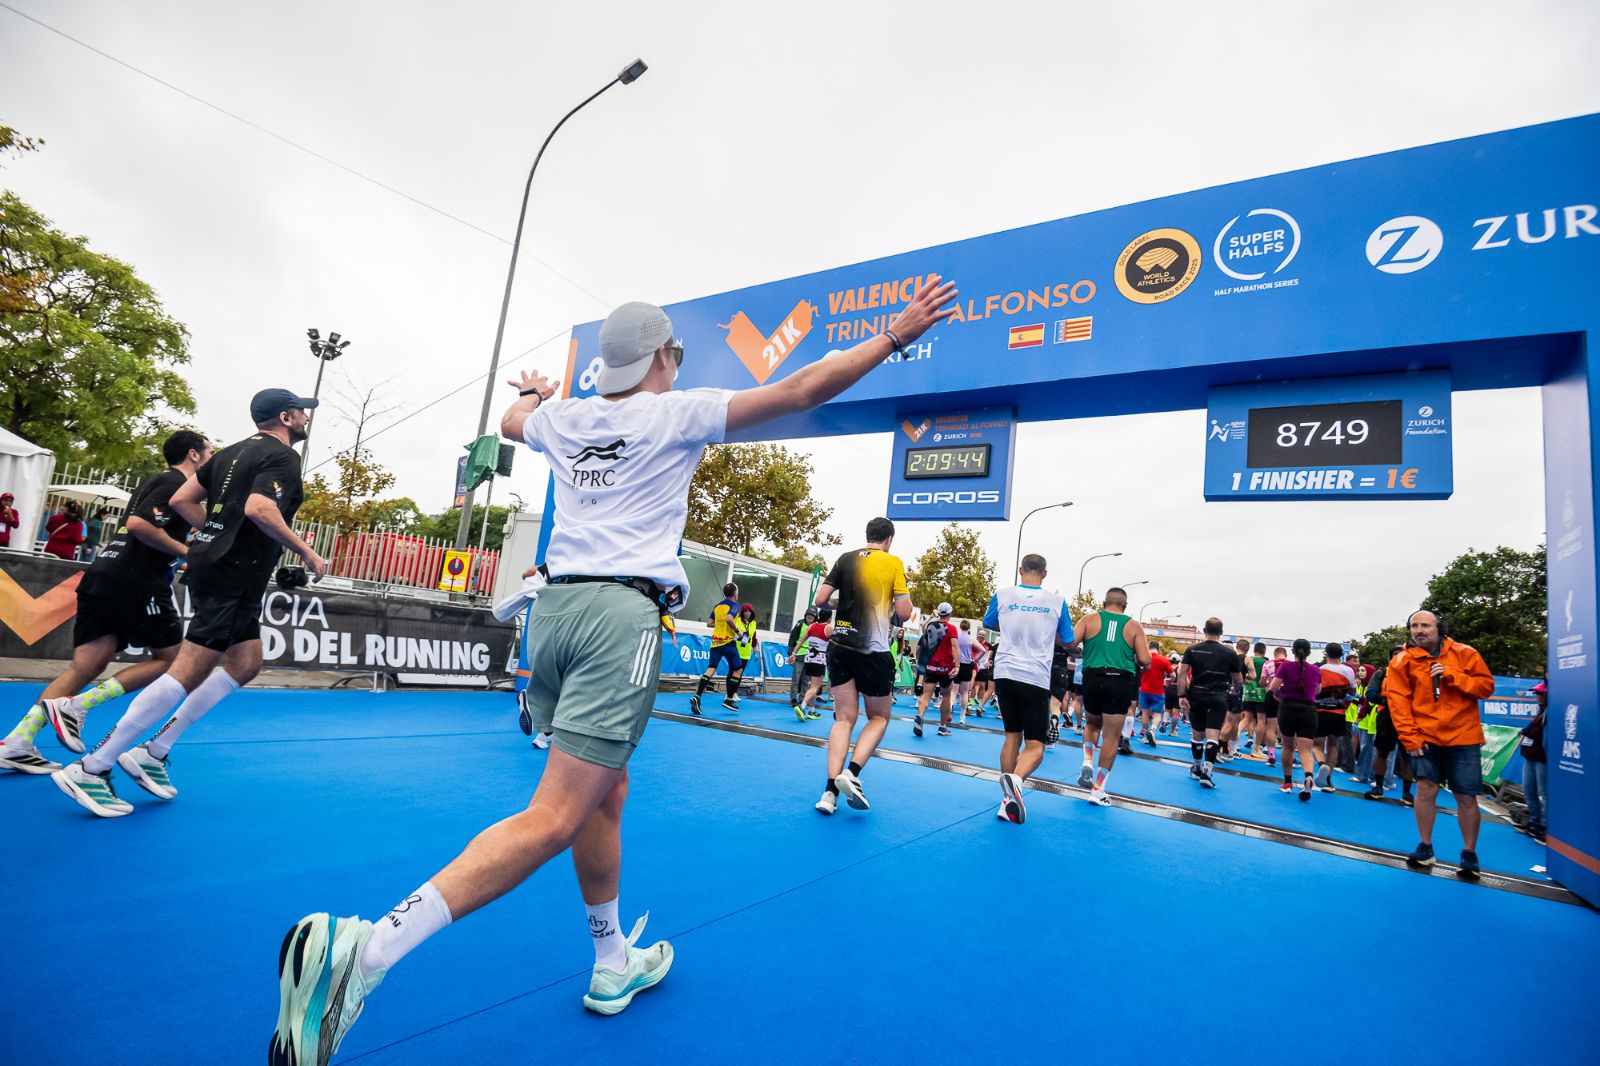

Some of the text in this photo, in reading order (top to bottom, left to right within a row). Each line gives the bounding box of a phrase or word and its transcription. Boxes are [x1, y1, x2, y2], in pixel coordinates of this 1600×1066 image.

[1229, 229, 1285, 248] SUPER
[1118, 236, 1151, 266] GOLD LABEL
[1228, 242, 1285, 260] HALFS
[1137, 276, 1176, 287] ATHLETICS
[1143, 271, 1170, 281] WORLD
[1154, 258, 1199, 300] ROAD RACE 2025
[1214, 278, 1299, 296] HALF MARATHON SERIES
[947, 279, 1097, 325] ALFONSO
[762, 317, 803, 370] 21K
[1405, 427, 1447, 436] Foundation
[1408, 419, 1445, 427] ZURICH
[1276, 420, 1369, 448] 8749
[910, 452, 983, 472] 2:09:44
[572, 469, 616, 487] TPRC
[1231, 472, 1242, 491] 1
[1249, 470, 1354, 491] FINISHER
[1386, 468, 1419, 489] 1€
[892, 490, 1000, 504] COROS
[1021, 605, 1050, 614] CEPSA
[293, 629, 358, 665] DEL
[364, 634, 491, 672] RUNNING
